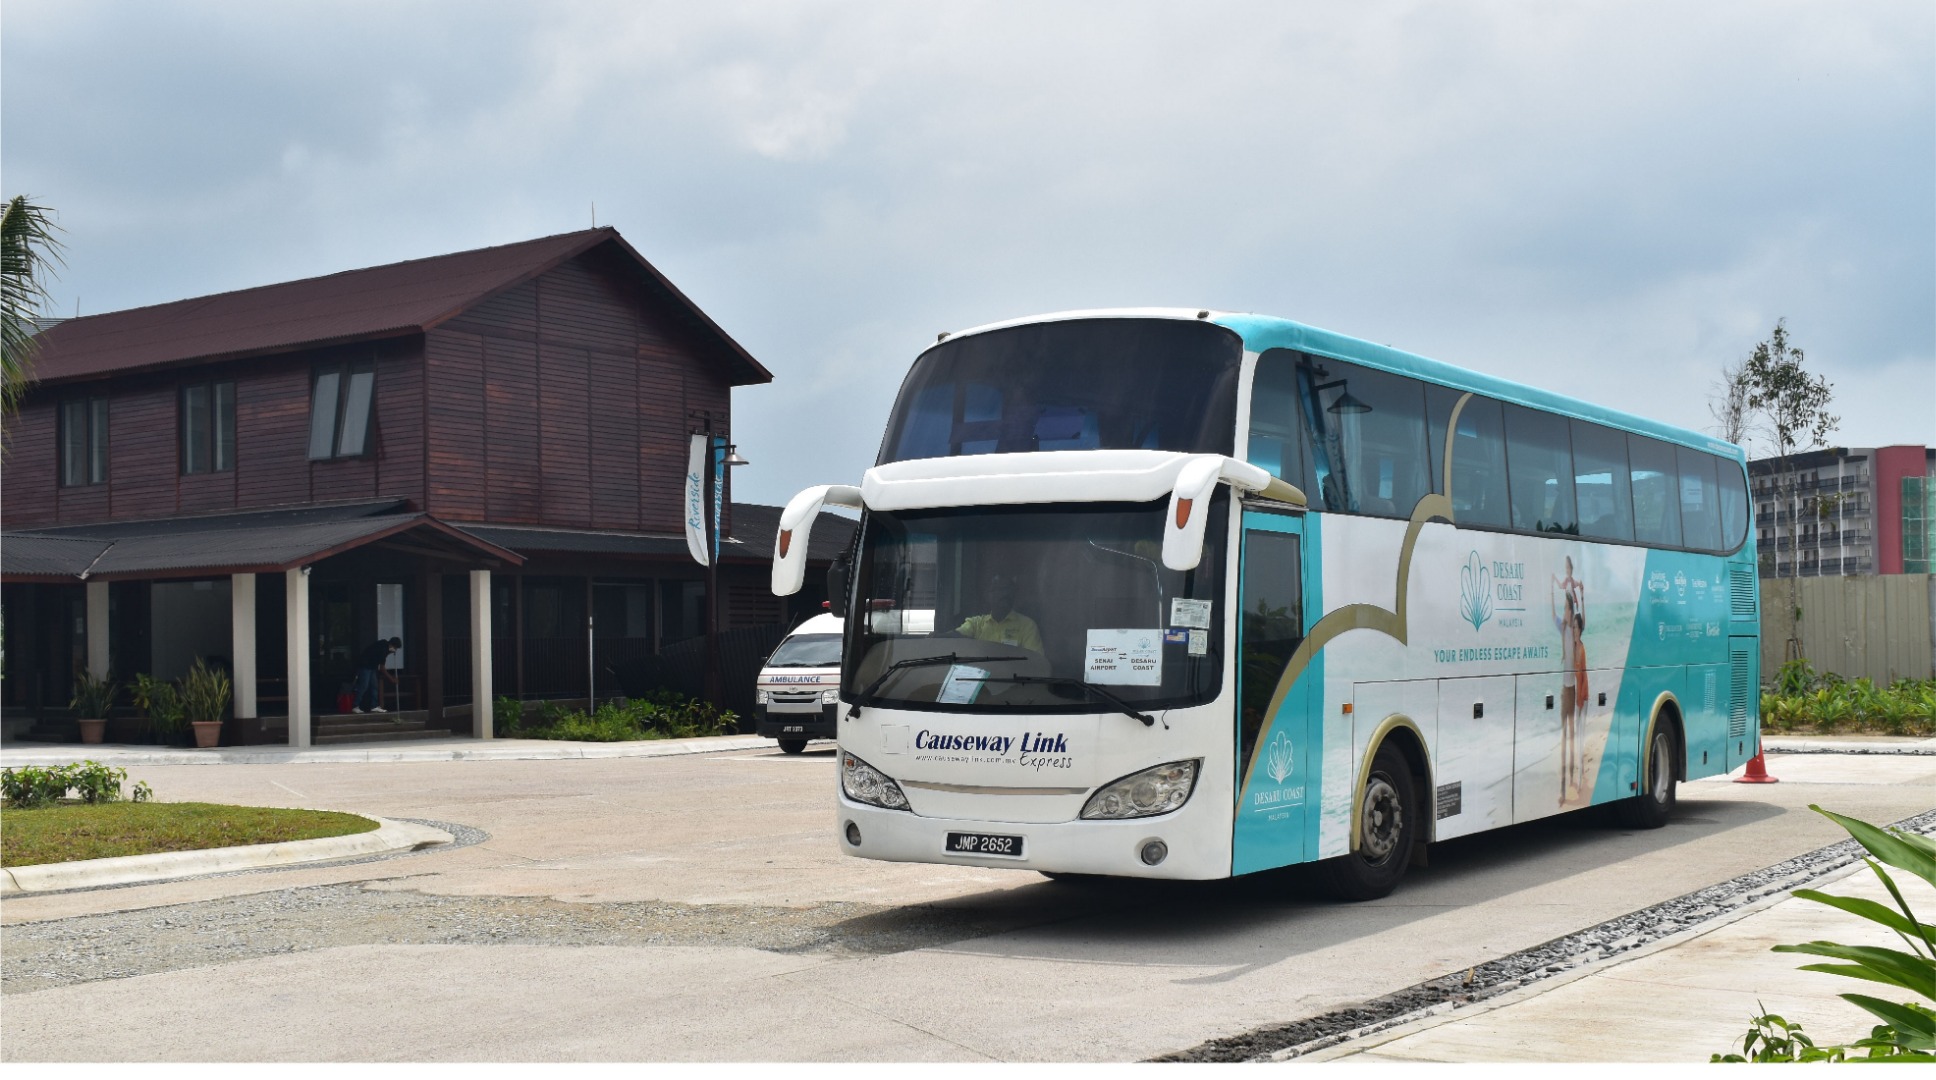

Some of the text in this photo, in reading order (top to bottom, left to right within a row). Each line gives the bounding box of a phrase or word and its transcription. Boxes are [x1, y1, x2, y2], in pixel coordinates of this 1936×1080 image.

[688, 472, 700, 530] Riverside
[1493, 561, 1524, 580] DESARU
[1497, 583, 1523, 601] COAST
[1434, 646, 1549, 663] YOUR ENDLESS ESCAPE AWAITS
[915, 729, 1069, 756] Causeway Link
[1019, 751, 1073, 772] Express
[1255, 786, 1303, 805] DESARU COAST
[955, 835, 1012, 853] JMP 2652
